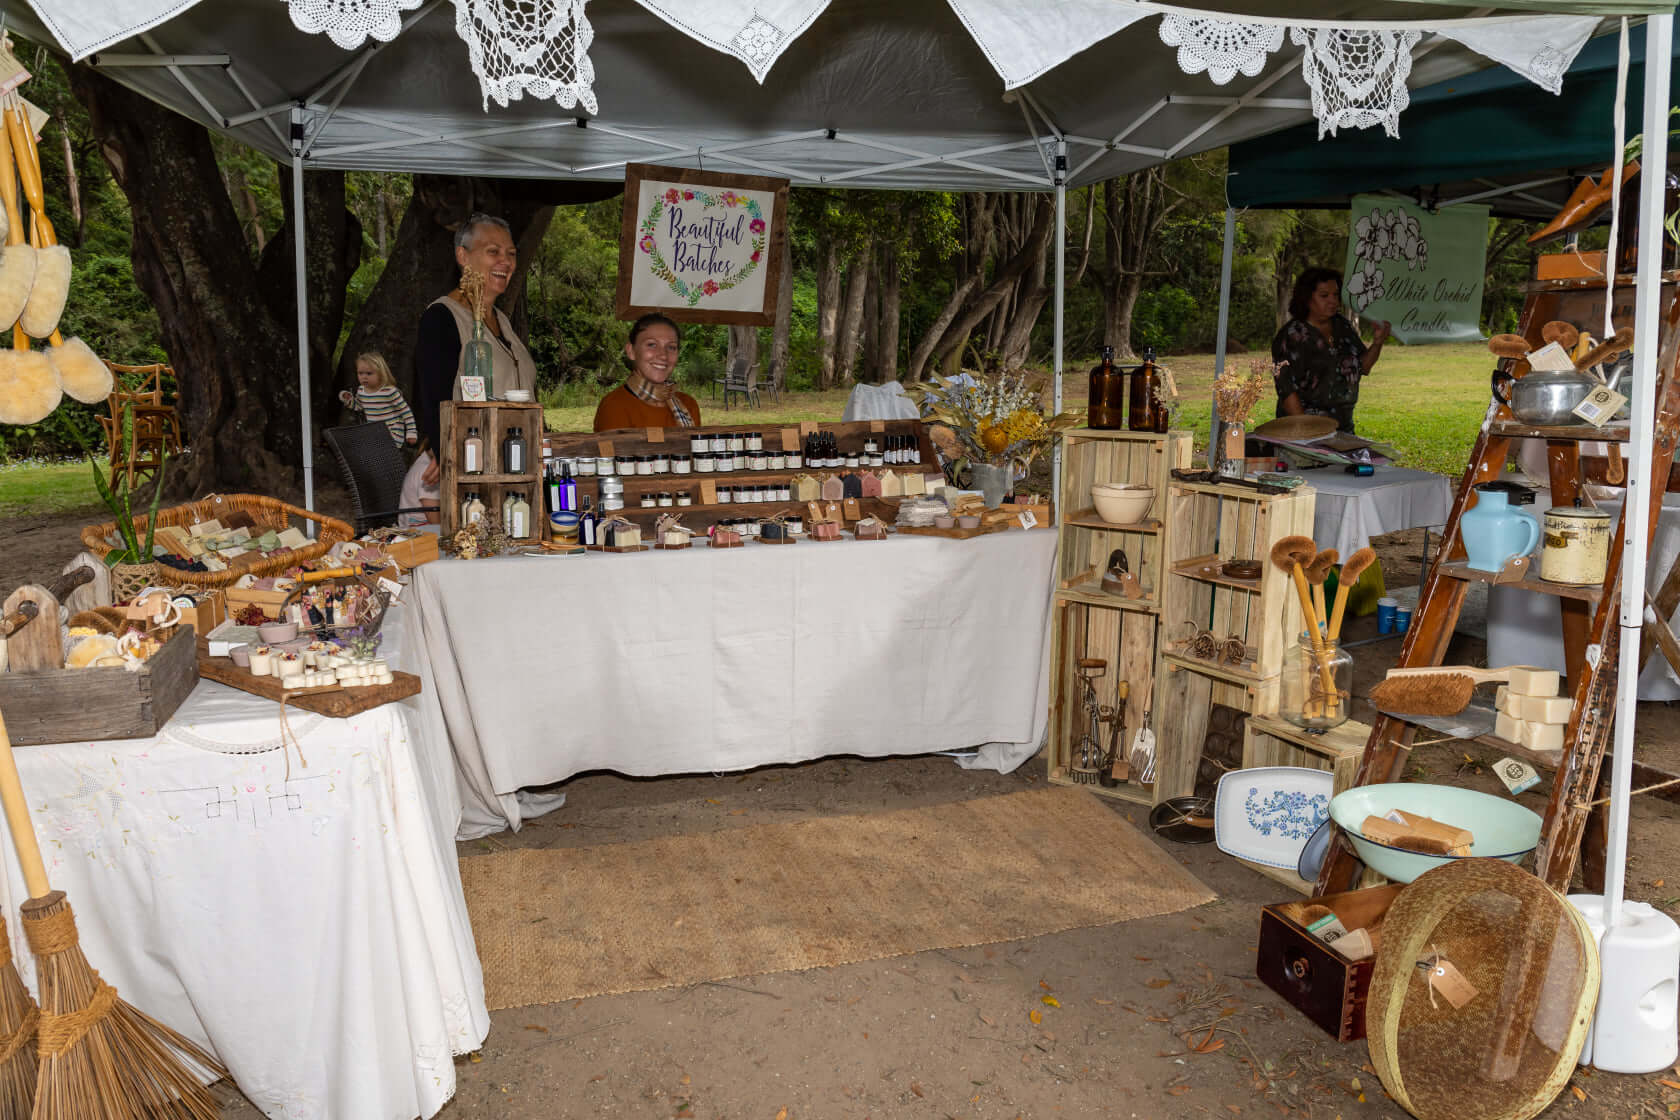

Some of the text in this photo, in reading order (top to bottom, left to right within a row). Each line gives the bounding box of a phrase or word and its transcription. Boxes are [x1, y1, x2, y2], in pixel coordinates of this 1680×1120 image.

[668, 205, 745, 248] Beautiful
[672, 239, 735, 275] Batches
[1385, 276, 1478, 303] White Orchid
